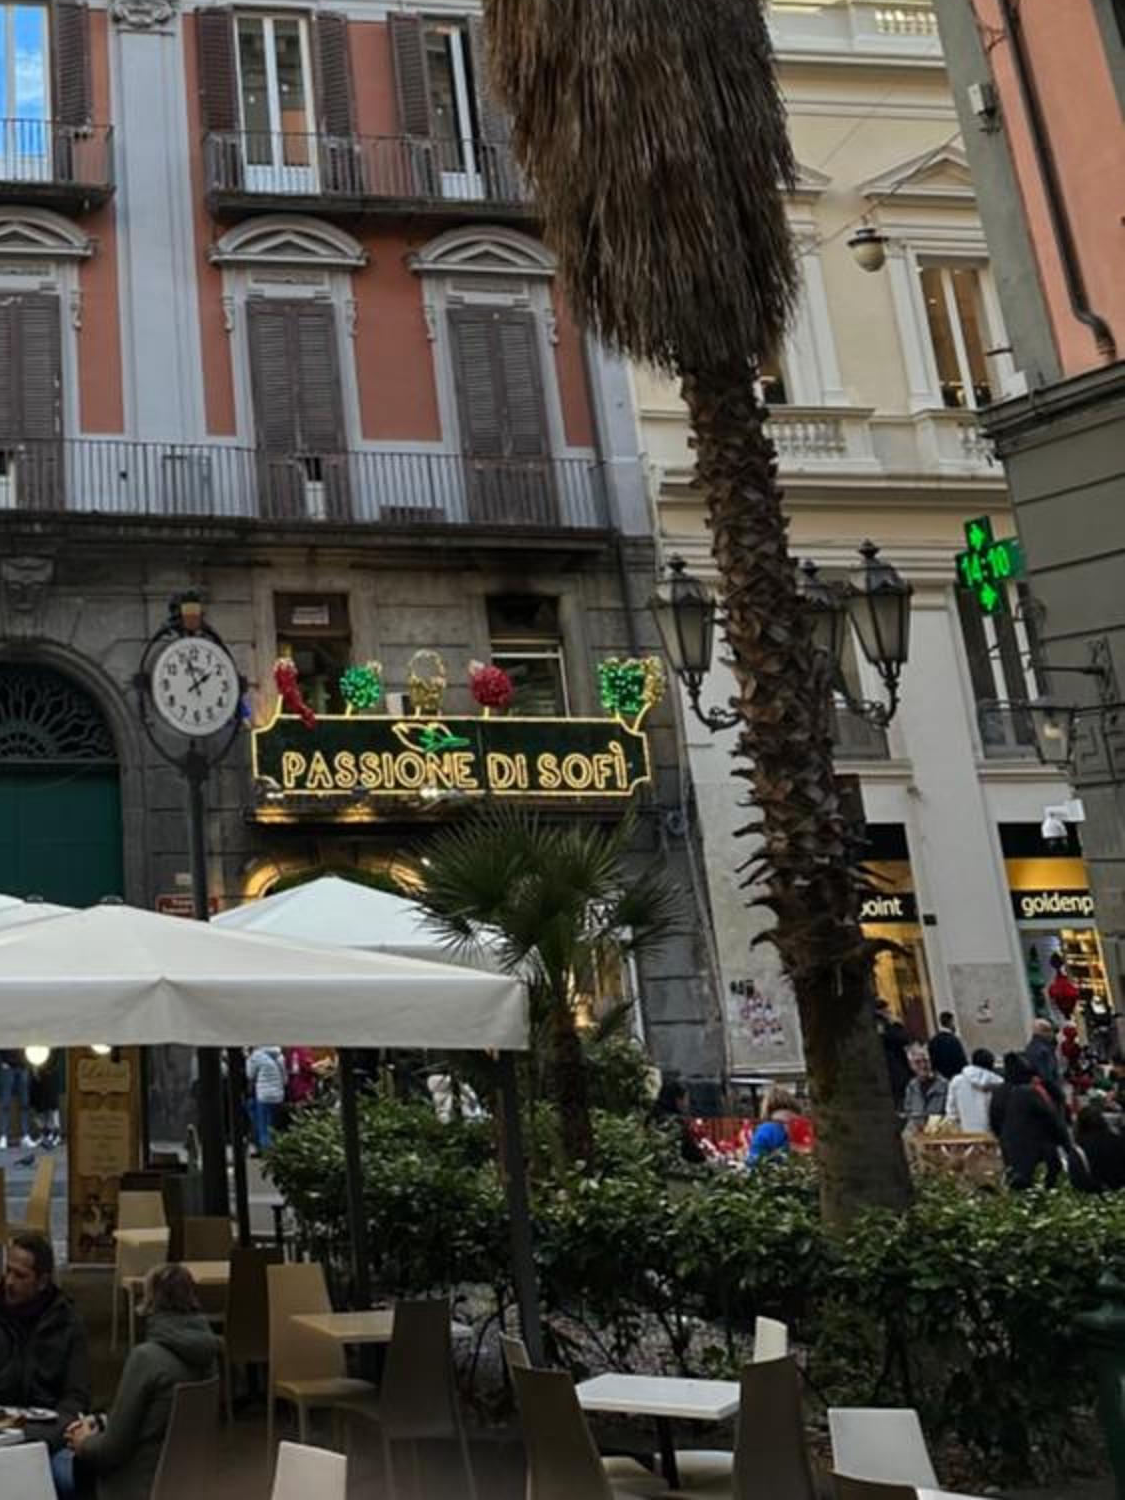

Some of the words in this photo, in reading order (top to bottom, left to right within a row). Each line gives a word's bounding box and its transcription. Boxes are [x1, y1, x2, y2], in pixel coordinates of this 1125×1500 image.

[962, 546, 1010, 585] 14:10
[282, 751, 477, 789] PASSIONE
[486, 753, 528, 789] DI
[538, 740, 628, 790] SOFÌ
